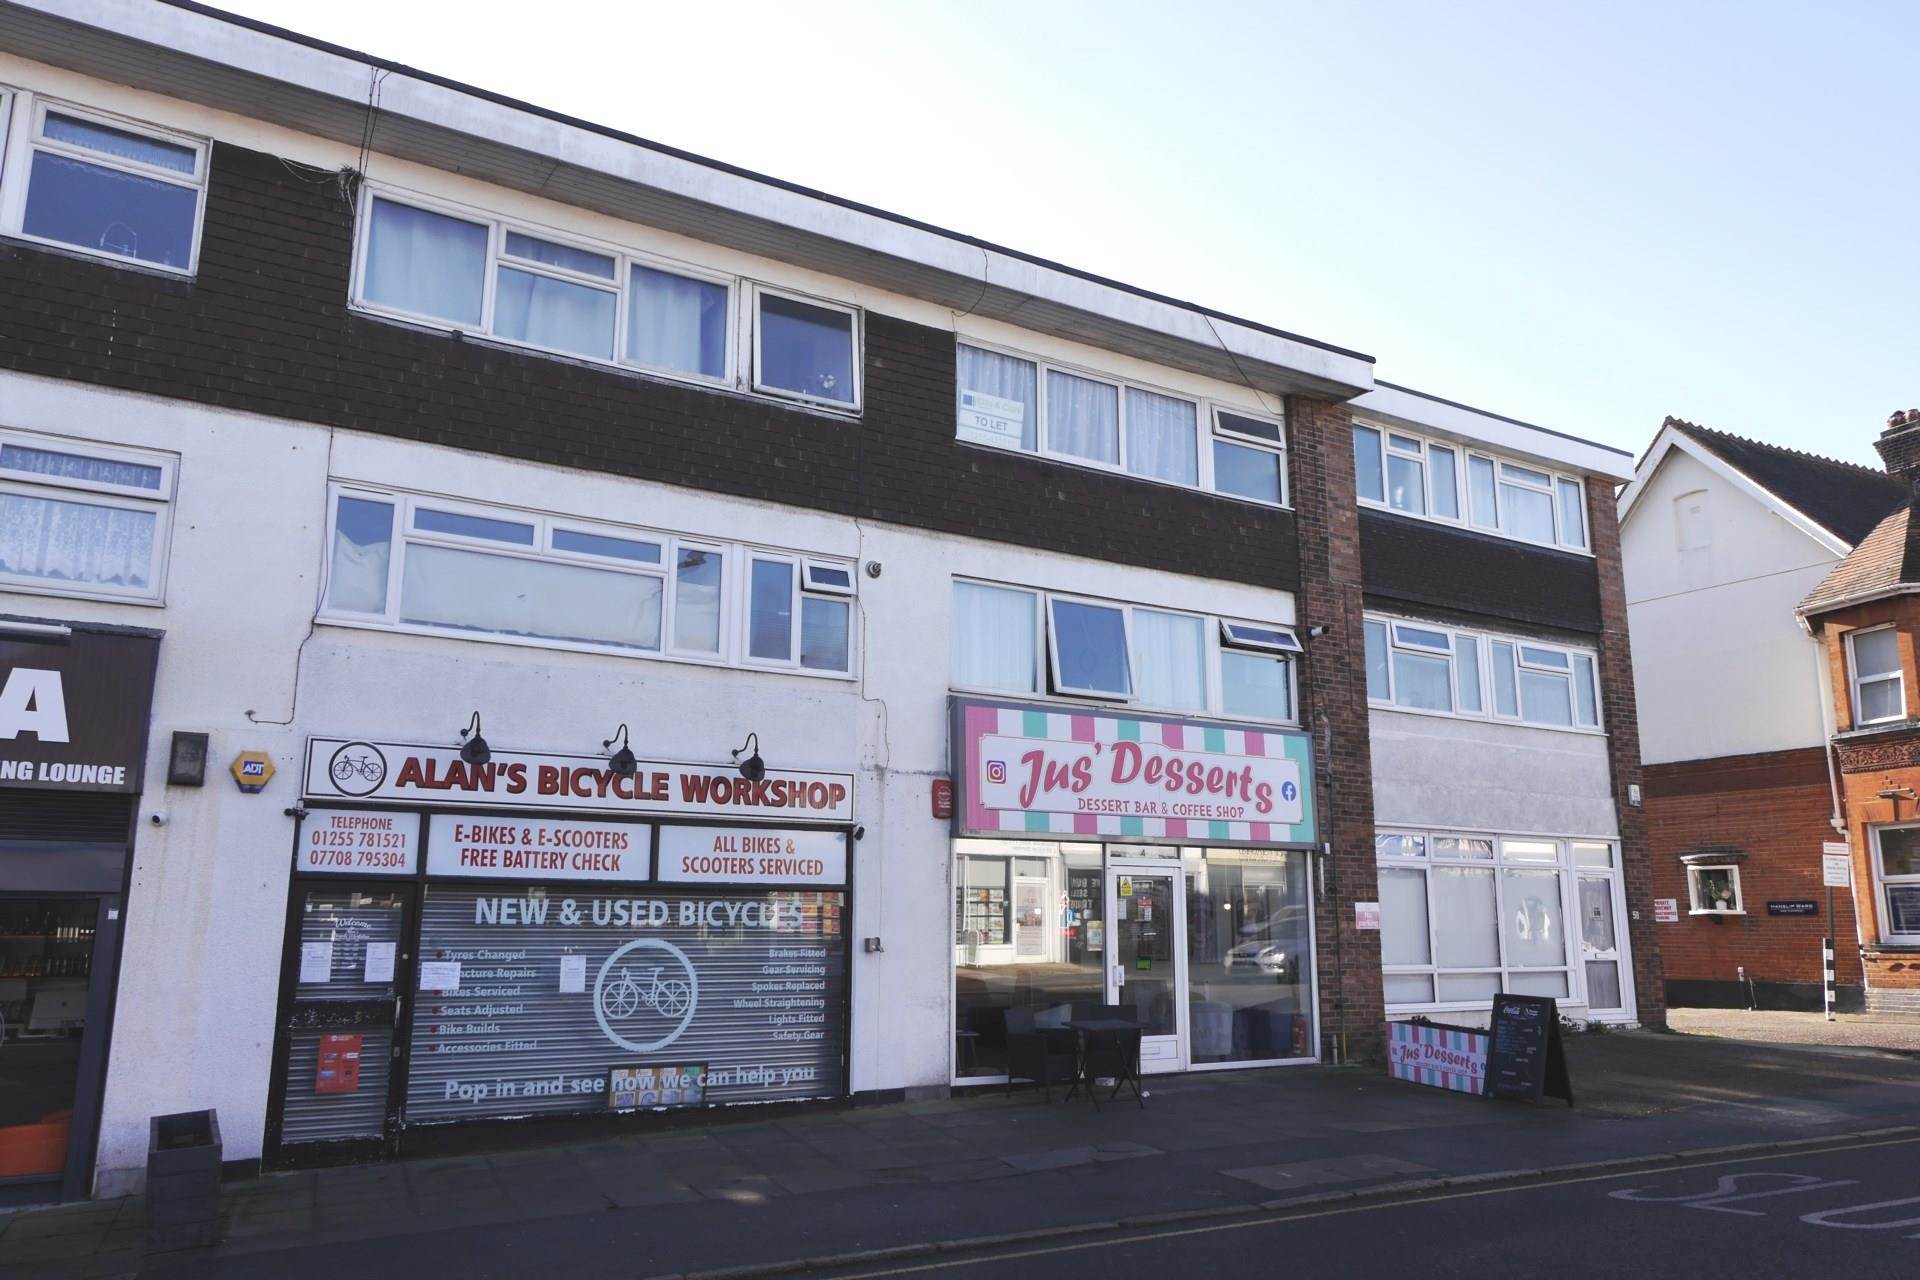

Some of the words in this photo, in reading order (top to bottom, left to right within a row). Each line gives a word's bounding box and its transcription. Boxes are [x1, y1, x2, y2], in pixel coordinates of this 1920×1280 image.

[975, 416, 988, 427] TO
[990, 419, 1008, 432] LET
[39, 762, 126, 785] LOUNGE
[243, 761, 265, 776] ADT
[395, 757, 527, 794] ALAN'S
[537, 765, 669, 801] BICYCLE
[680, 774, 845, 810] WORKSHOP
[1110, 741, 1273, 814] Desserts
[1078, 798, 1130, 812] DESSERT
[1135, 801, 1158, 814] BAR
[1161, 802, 1168, 815] &
[1172, 803, 1212, 817] COFFEE
[1216, 806, 1245, 818] SHOP
[331, 816, 392, 830] TELEPHONE
[312, 831, 353, 847] 01255
[358, 832, 406, 848] 781521
[455, 824, 516, 845] E-BIKES
[521, 828, 532, 846] &
[538, 828, 628, 849] E-SCOOTERS
[713, 836, 737, 853] ALL
[742, 837, 781, 854] BIKES
[786, 838, 795, 854] &
[310, 850, 352, 866] 07708
[356, 852, 405, 867] 795304
[461, 848, 497, 867] FREE
[503, 850, 568, 870] BATTERY
[572, 853, 621, 872] CHECK
[682, 856, 754, 875] SCOOTERS
[759, 858, 823, 876] SERVICED
[475, 898, 549, 925] NEW
[559, 899, 583, 925] &
[592, 899, 669, 926] USED
[679, 901, 803, 928] BICYCLES
[445, 950, 474, 961] Tyres
[477, 950, 526, 961] Changed
[769, 949, 798, 958] Brakes
[801, 949, 826, 958] Fitted
[497, 968, 536, 980] Repairs
[762, 965, 783, 975] Gear
[786, 965, 826, 975] Servicing
[474, 986, 520, 997] Serviced
[752, 982, 782, 993] Spokes
[786, 981, 825, 992] Replaced
[440, 1006, 470, 1016] Seats
[474, 1004, 523, 1017] Adjusted
[733, 999, 761, 1008] Wheel
[765, 998, 825, 1009] Straightening
[769, 1014, 795, 1025] Lights
[798, 1013, 824, 1023] Fitted
[440, 1024, 463, 1034] Bike
[467, 1023, 501, 1034] Builds
[773, 1031, 801, 1041] Safety
[804, 1030, 824, 1040] Gear
[438, 1042, 501, 1053] Accessories
[505, 1040, 537, 1050] Fitted
[1424, 1043, 1478, 1074] Desserts
[445, 1079, 487, 1104] Pop
[496, 1078, 515, 1098] in
[523, 1074, 563, 1096] and
[571, 1078, 604, 1093] see
[611, 1069, 655, 1092] how
[660, 1073, 690, 1089] we
[697, 1070, 729, 1087] can
[736, 1065, 775, 1088] help
[782, 1066, 815, 1086] you
